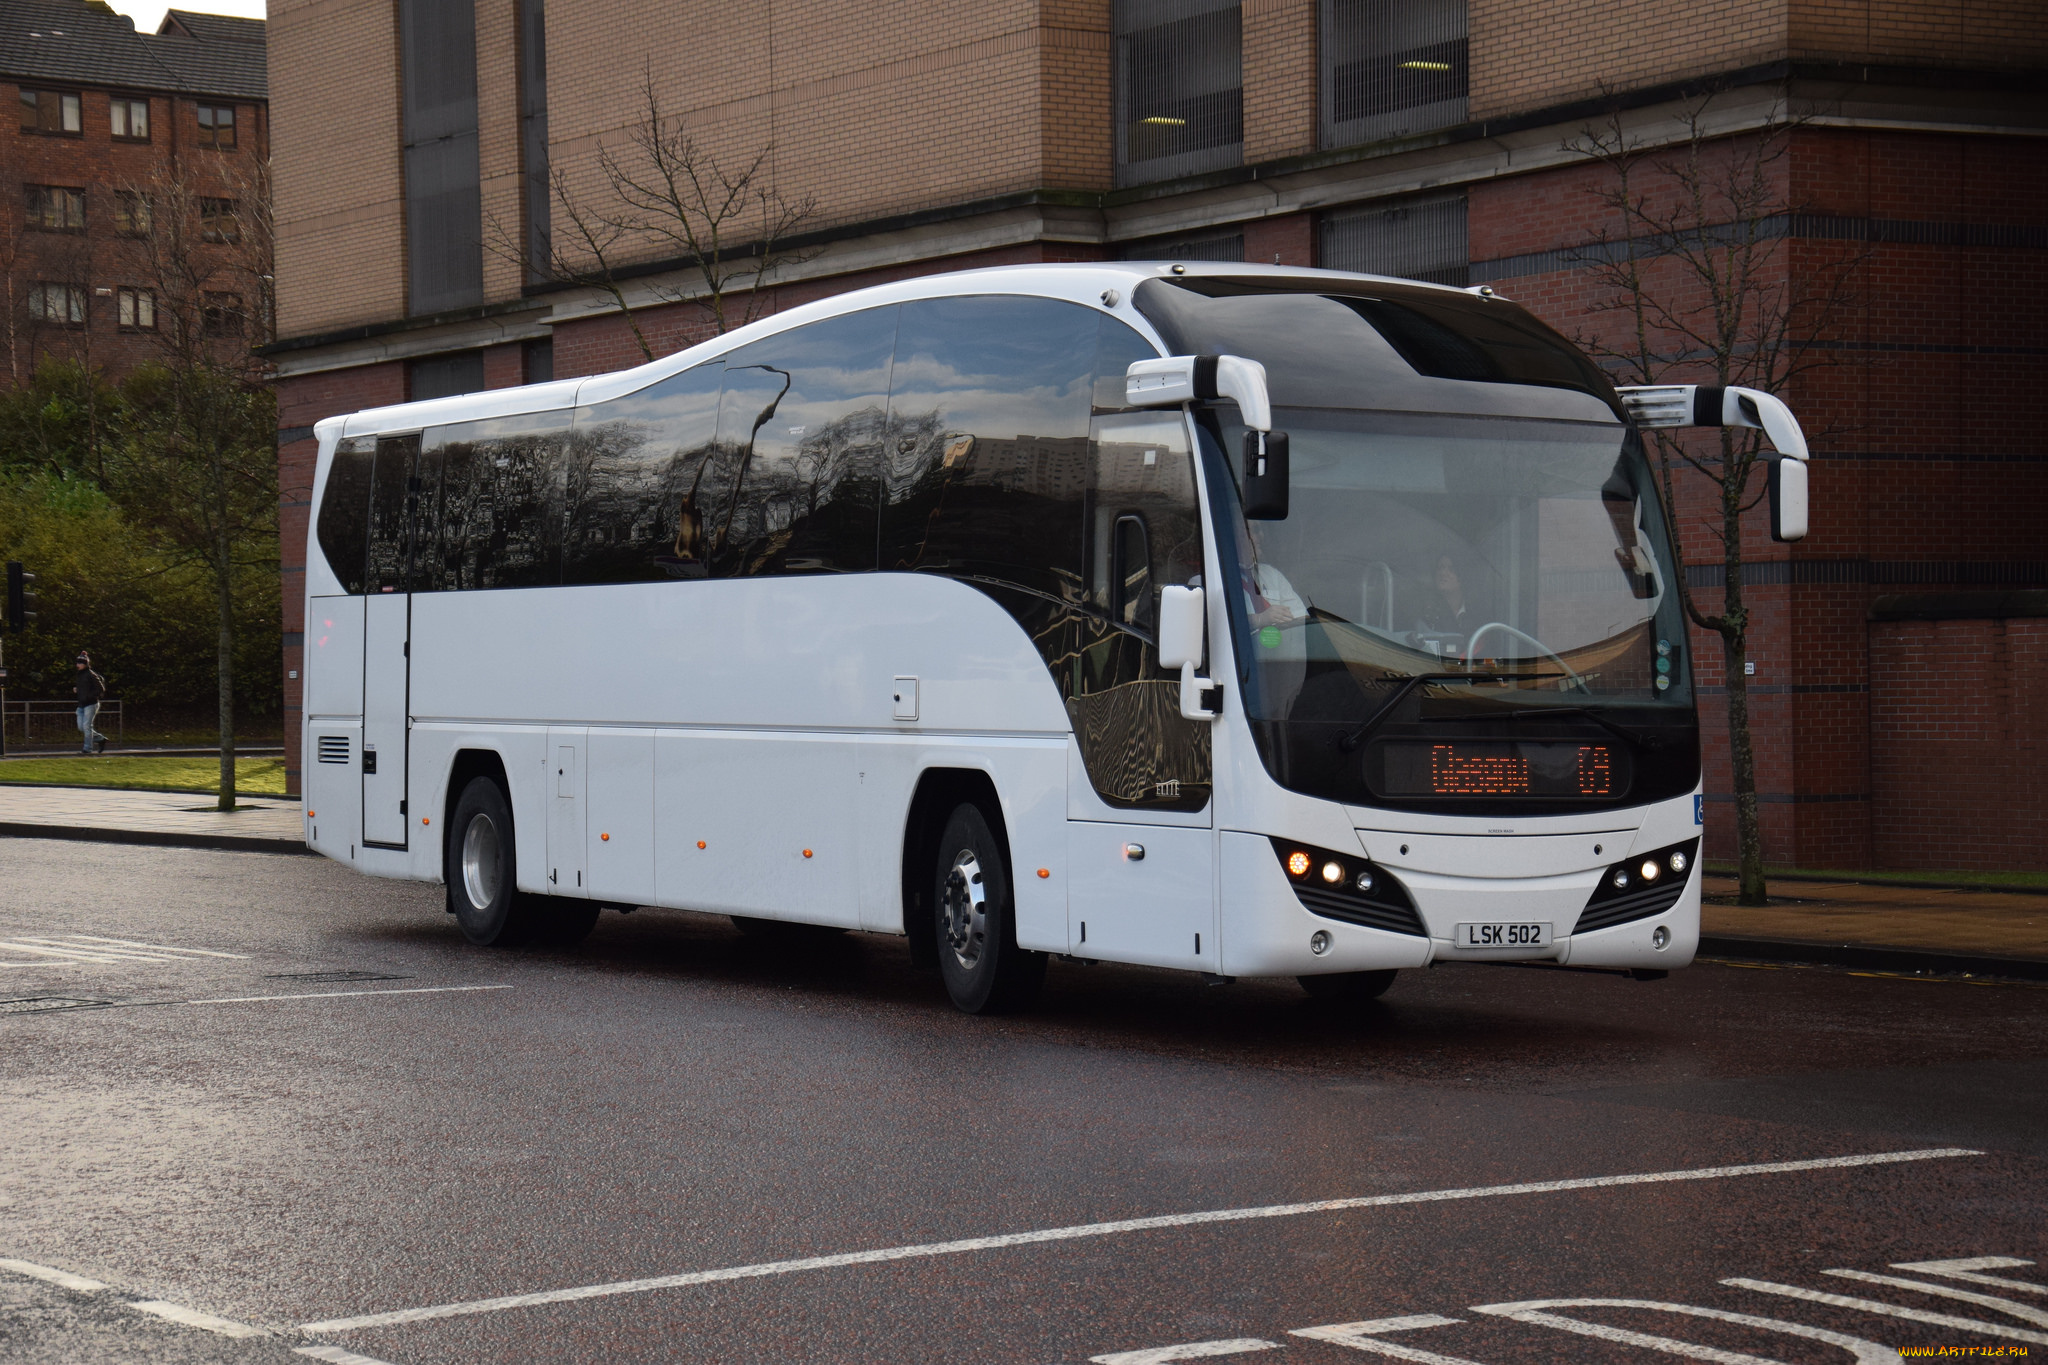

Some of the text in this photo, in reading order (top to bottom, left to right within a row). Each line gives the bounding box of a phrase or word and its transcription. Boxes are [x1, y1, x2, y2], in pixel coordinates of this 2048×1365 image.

[1432, 745, 1528, 793] Glasgow
[1156, 780, 1180, 796] ELITE
[1469, 925, 1541, 944] LSK 502
